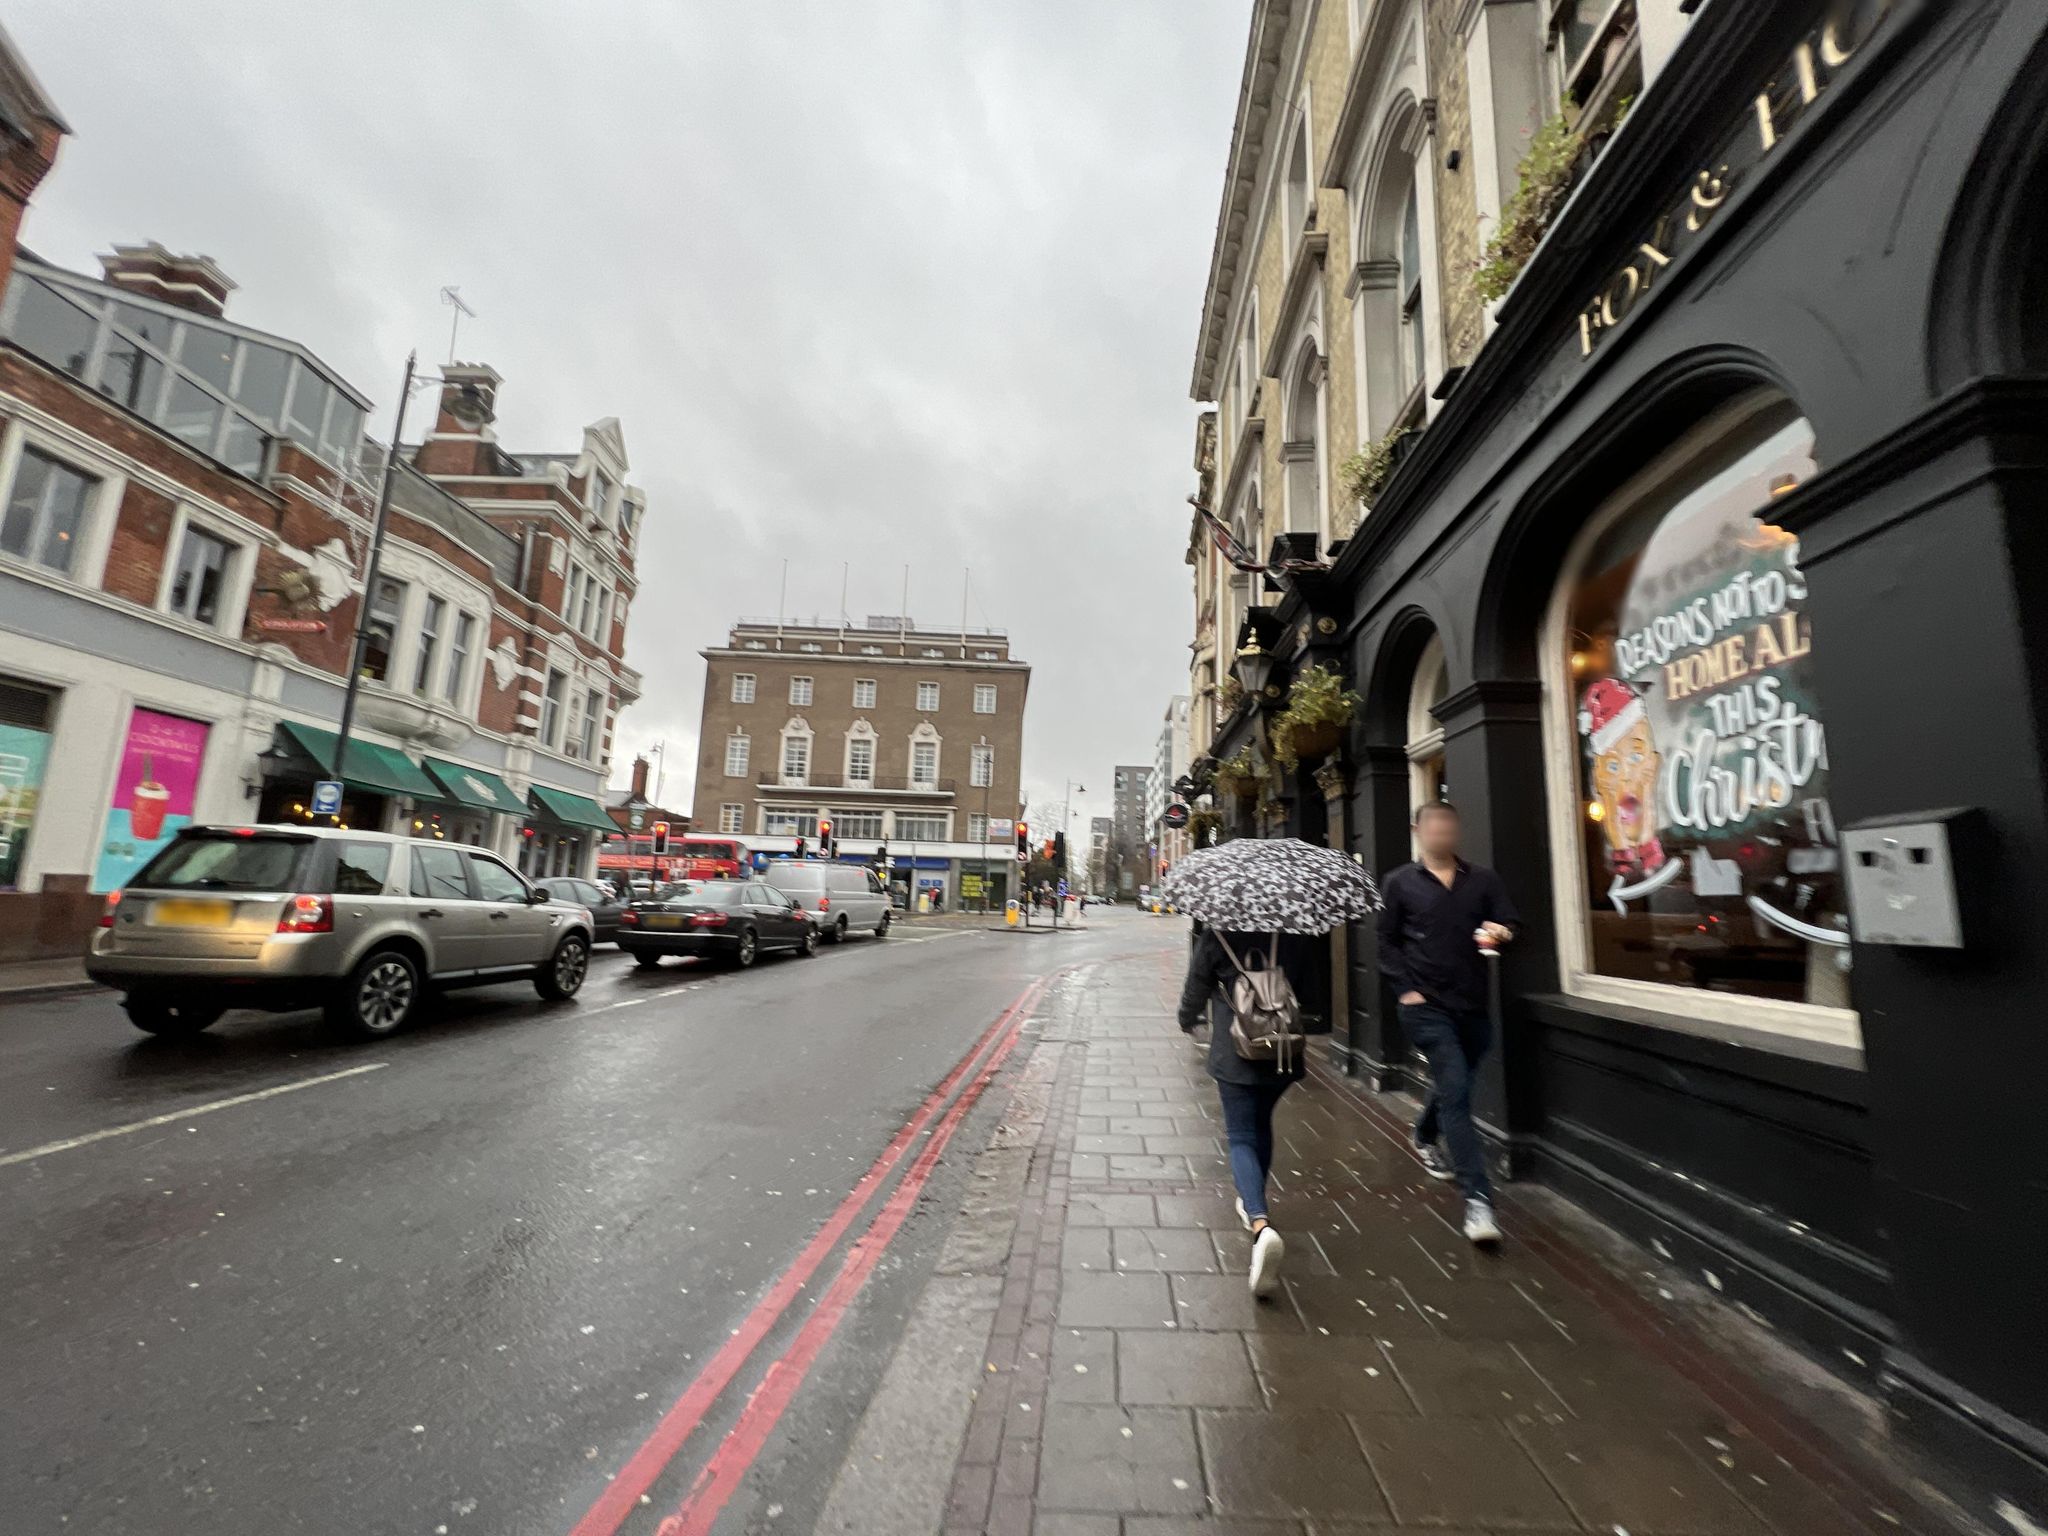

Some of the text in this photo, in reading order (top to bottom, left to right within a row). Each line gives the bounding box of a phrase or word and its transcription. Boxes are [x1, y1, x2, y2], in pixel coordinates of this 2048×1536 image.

[1578, 214, 1673, 356] FOX
[1686, 164, 1730, 232] &
[1614, 597, 1715, 679] REASONS
[1711, 570, 1752, 631] NOT
[1750, 570, 1787, 617] TO
[1664, 634, 1750, 700] HOME
[1704, 675, 1781, 739] THIS
